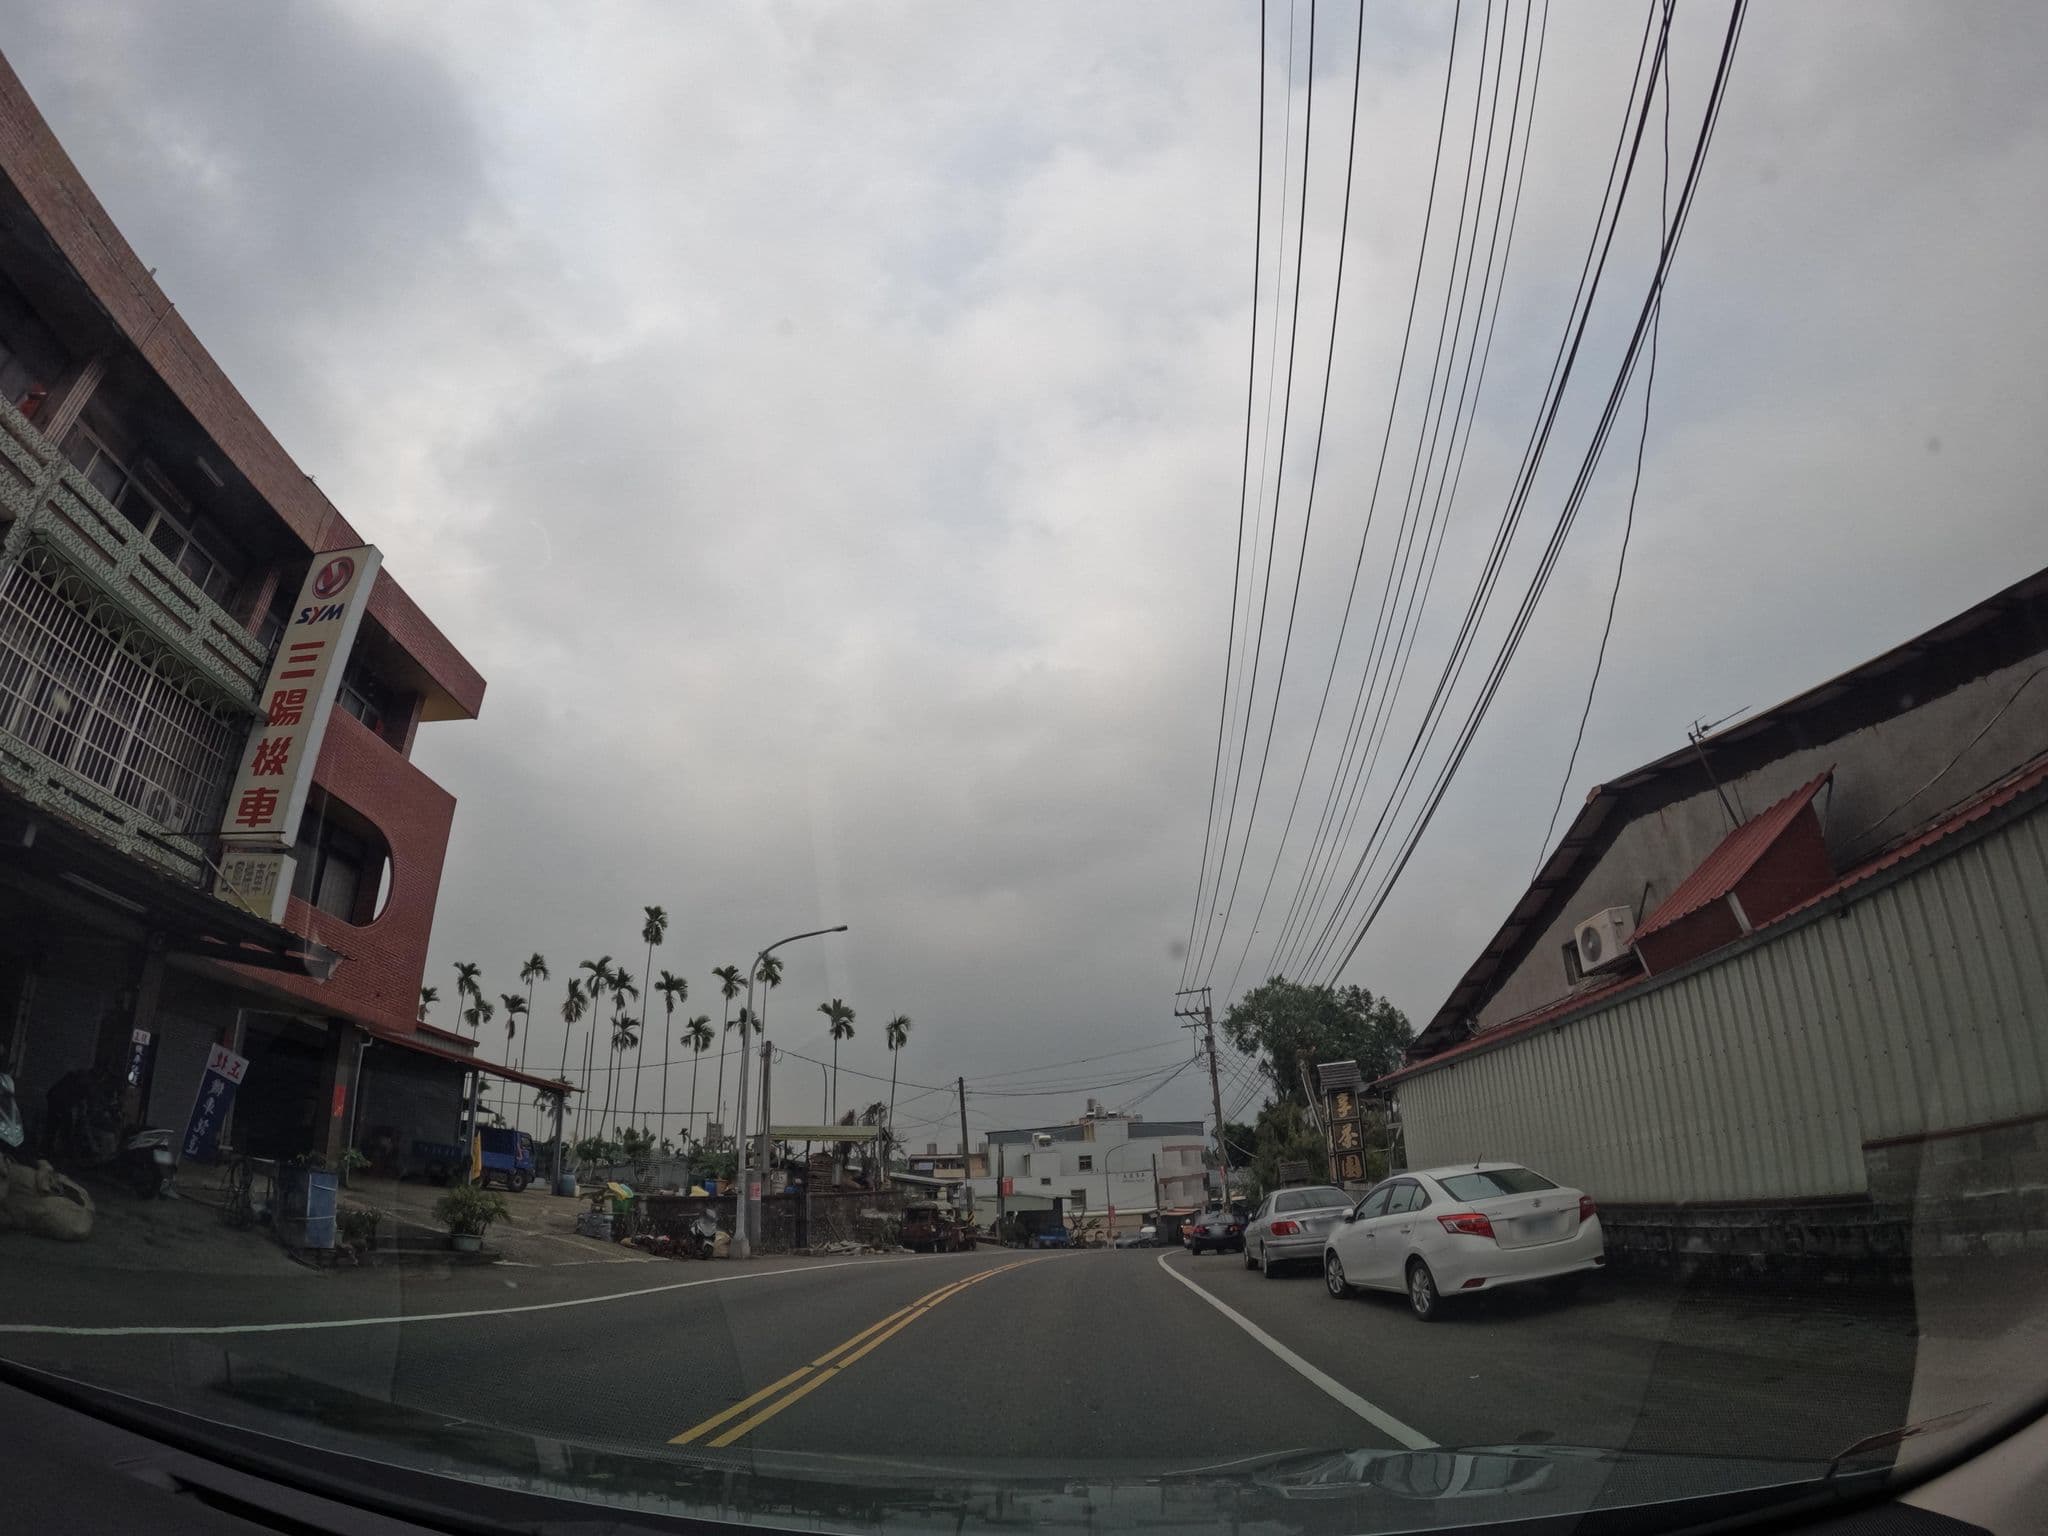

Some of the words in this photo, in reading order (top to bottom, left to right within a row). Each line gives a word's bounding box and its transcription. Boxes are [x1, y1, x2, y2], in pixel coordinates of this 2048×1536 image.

[295, 603, 345, 625] SYM
[235, 641, 325, 828] 三陽機車
